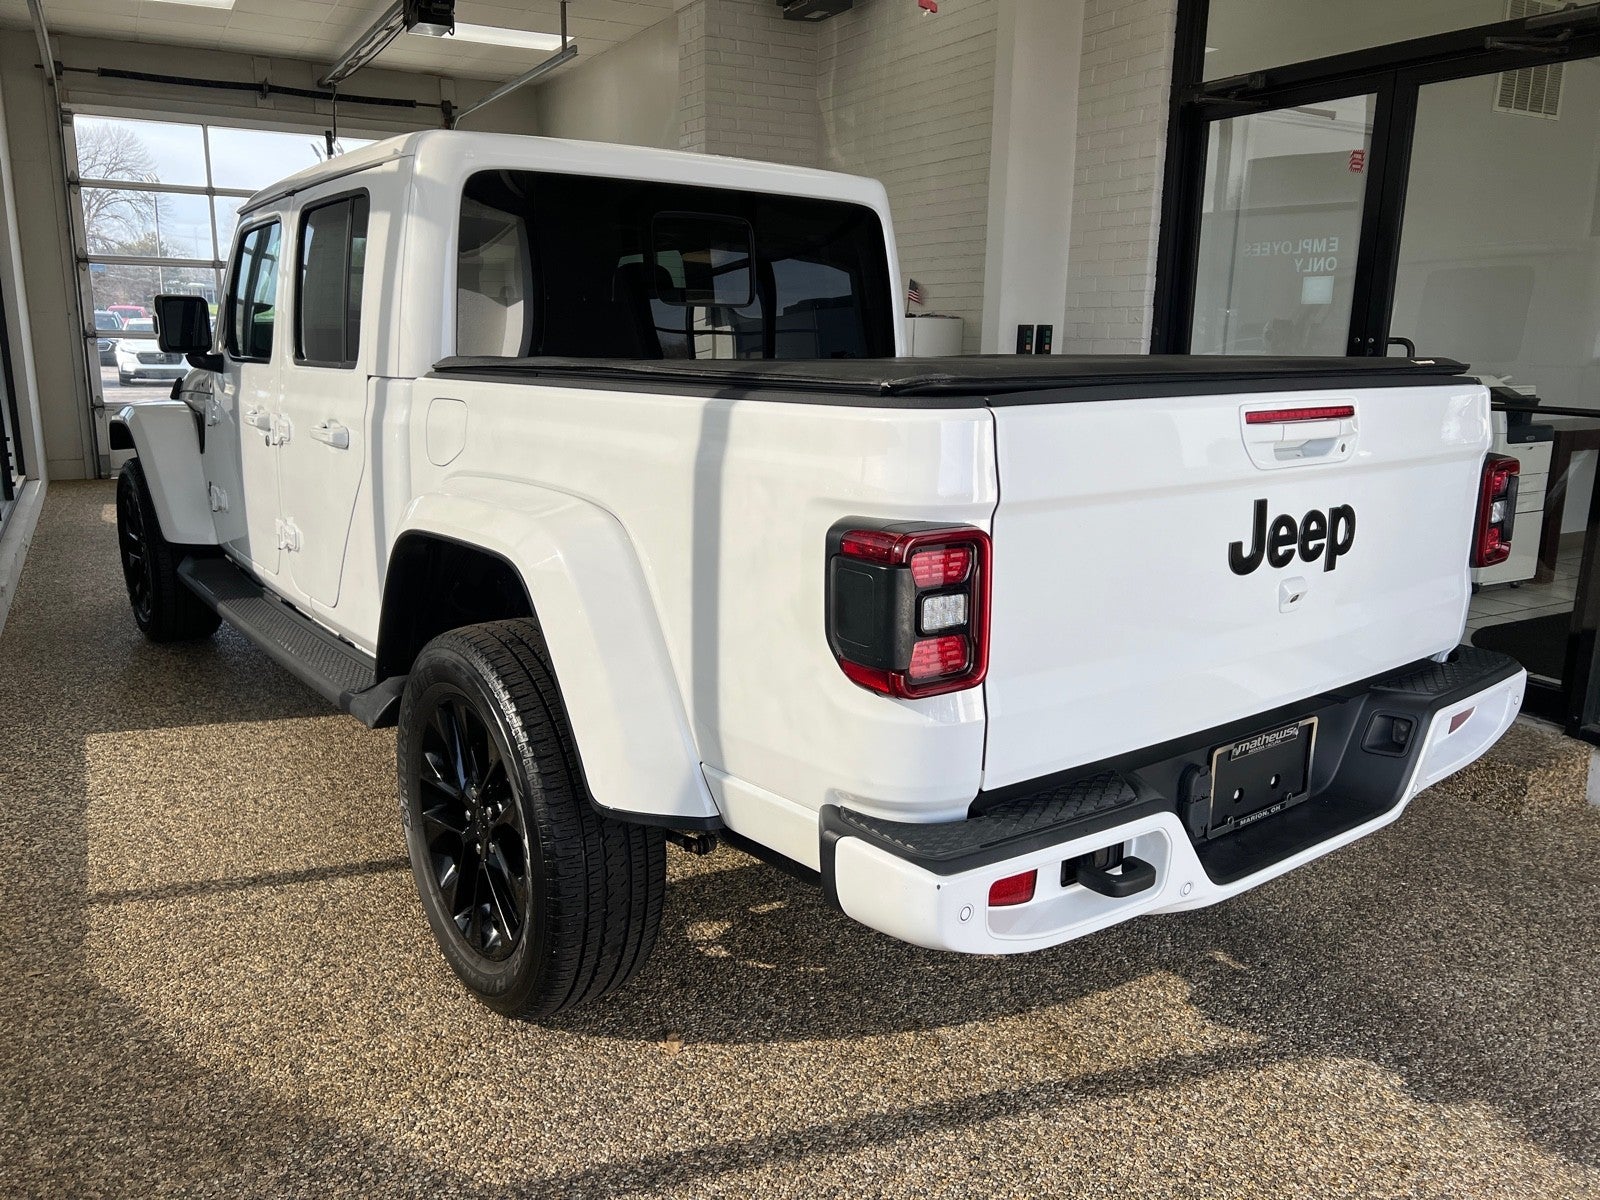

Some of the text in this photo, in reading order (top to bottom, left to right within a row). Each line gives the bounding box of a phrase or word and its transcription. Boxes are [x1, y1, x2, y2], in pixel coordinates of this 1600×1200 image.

[1228, 498, 1356, 576] Jeep
[1238, 727, 1294, 752] mathews
[1240, 804, 1281, 826] MARION, OH
